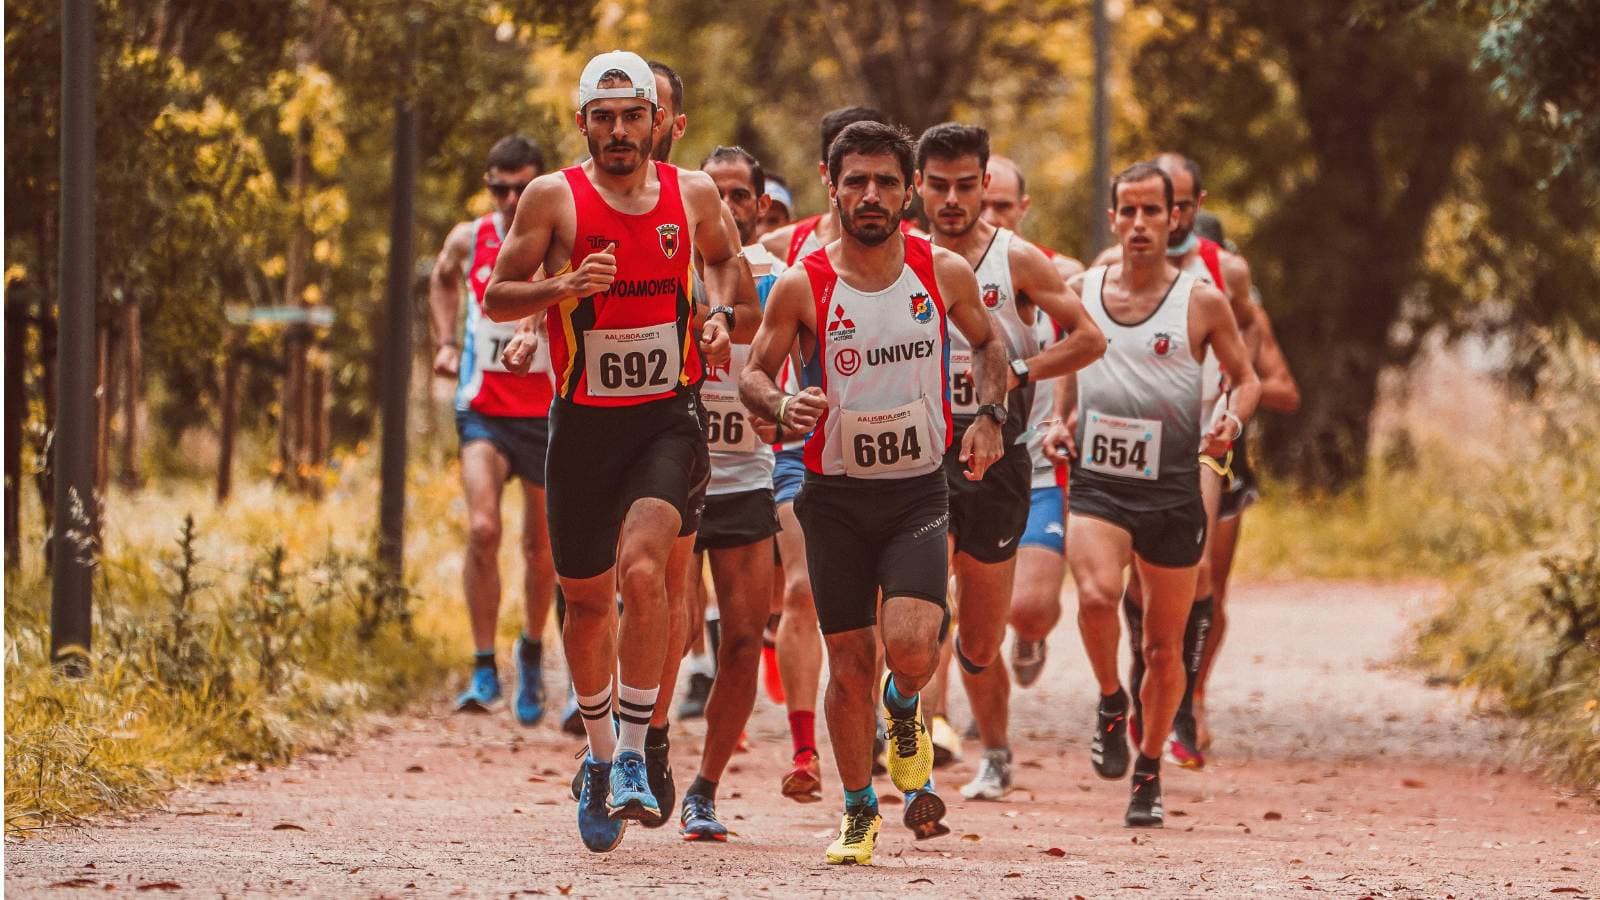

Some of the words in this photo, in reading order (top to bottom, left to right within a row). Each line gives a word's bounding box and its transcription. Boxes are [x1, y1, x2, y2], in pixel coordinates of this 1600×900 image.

[599, 348, 669, 389] 692
[866, 339, 935, 366] UNIVEX
[706, 410, 744, 445] 66
[853, 425, 922, 467] 684
[1092, 434, 1148, 472] 654
